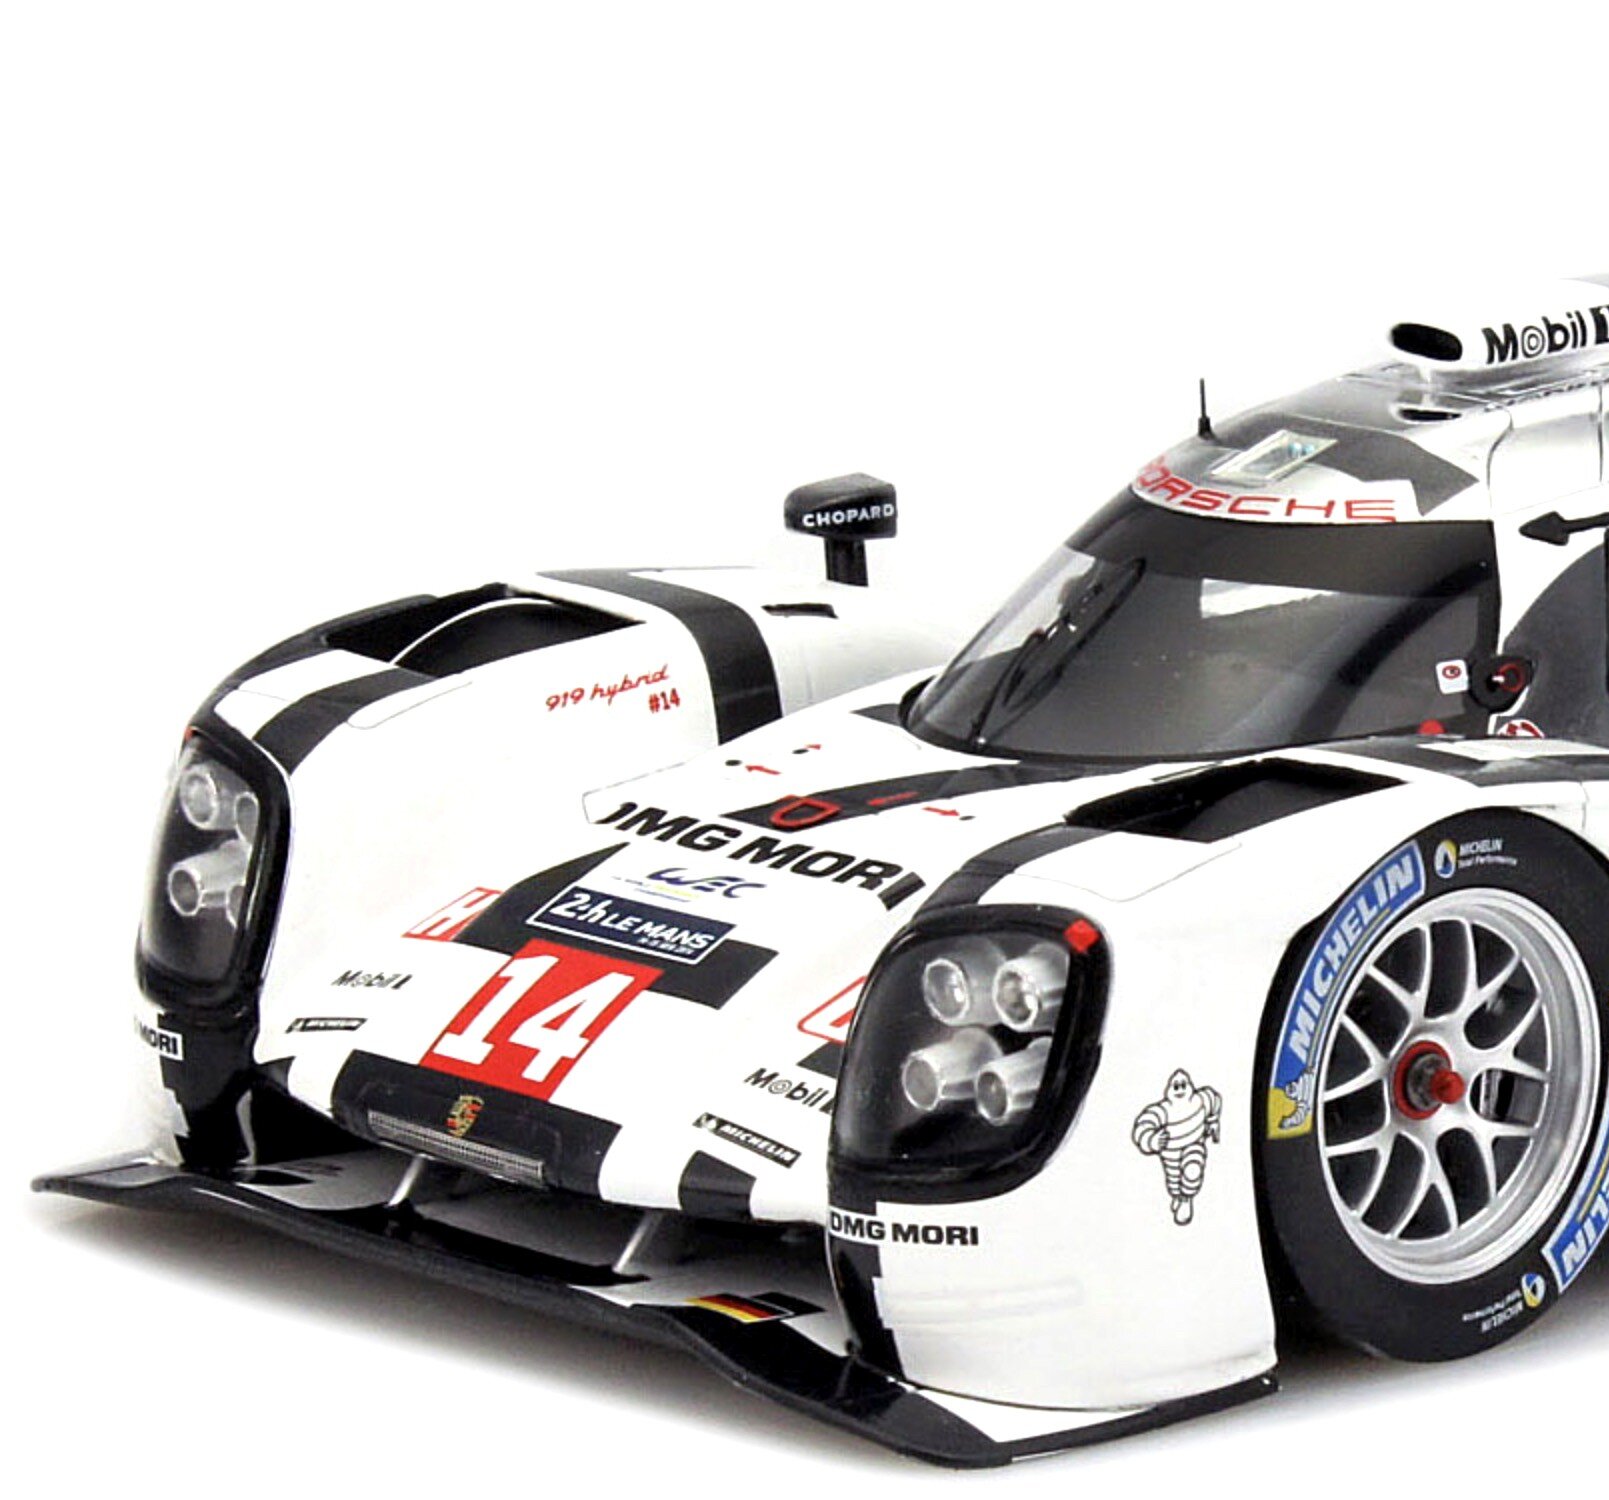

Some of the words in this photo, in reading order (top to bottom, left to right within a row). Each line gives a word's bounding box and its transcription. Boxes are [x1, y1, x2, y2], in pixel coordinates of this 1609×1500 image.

[1483, 309, 1589, 364] Mobil
[1137, 455, 1398, 523] ORSCHE
[802, 503, 895, 528] CHOPARD
[546, 687, 586, 712] 919
[590, 664, 670, 707] hybrid
[648, 688, 681, 714] #14
[727, 835, 926, 911] MORI
[601, 912, 643, 932] LE
[631, 919, 716, 950] MANS
[1288, 855, 1418, 1056] MICHELIN
[432, 955, 636, 1083] 14
[743, 1067, 831, 1108] Mobil
[830, 1210, 885, 1241] DMG
[891, 1222, 980, 1247] MORI
